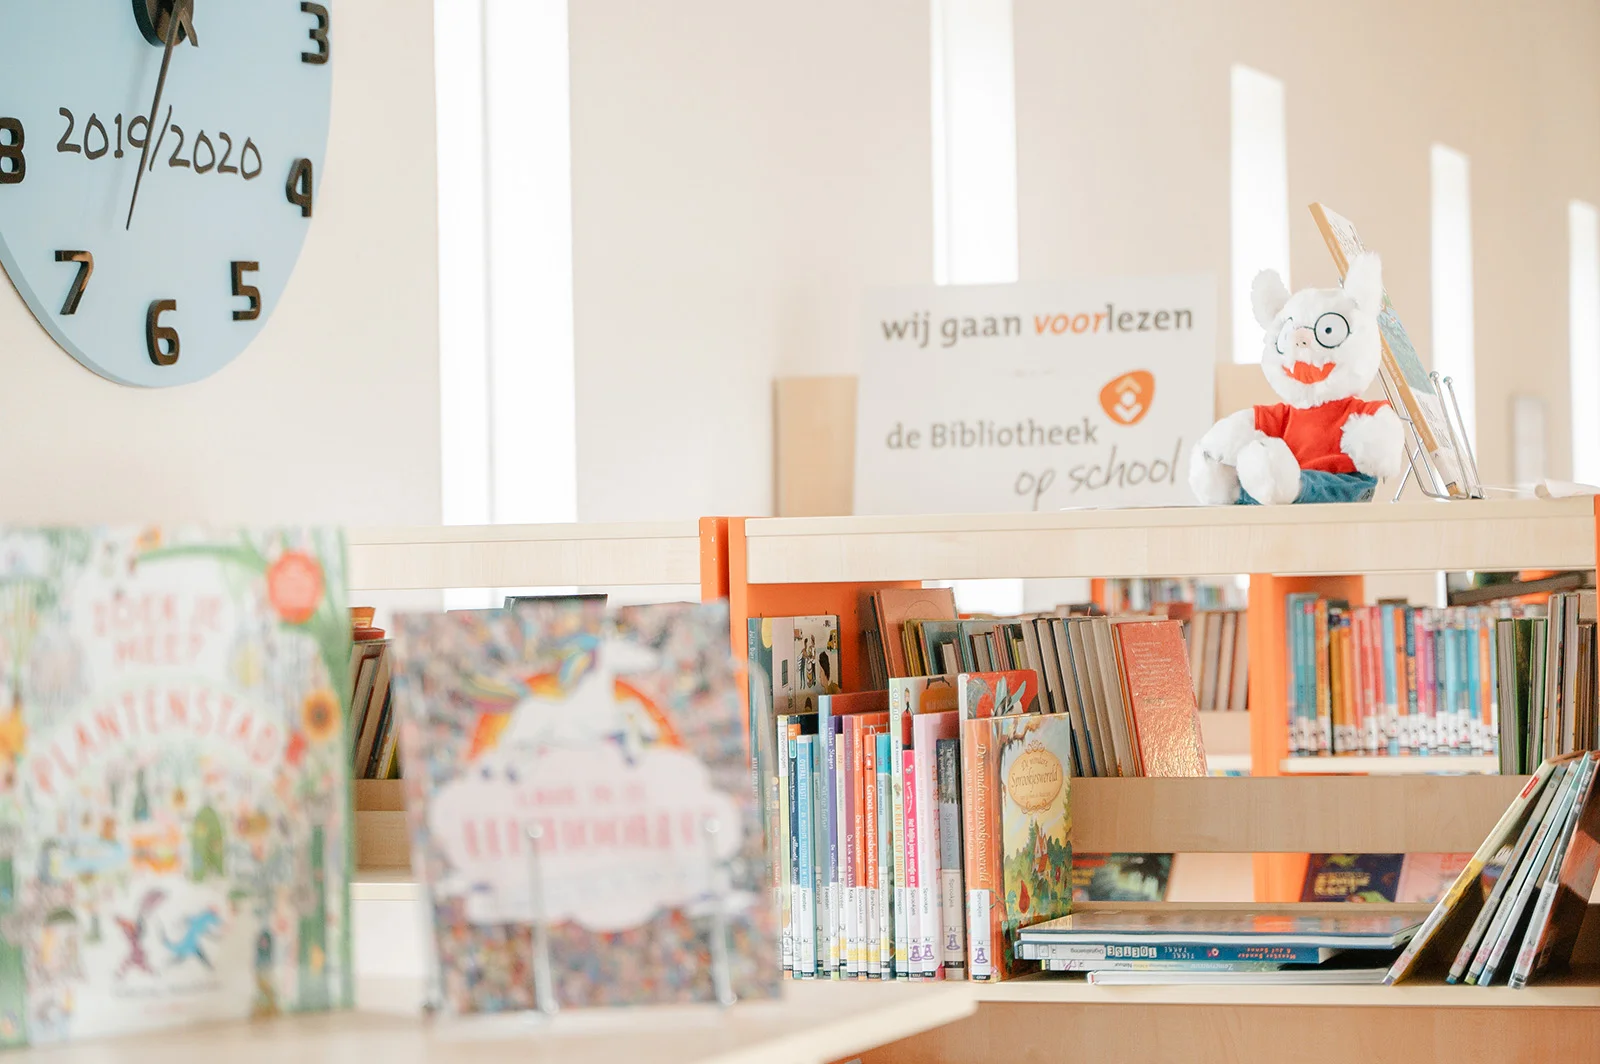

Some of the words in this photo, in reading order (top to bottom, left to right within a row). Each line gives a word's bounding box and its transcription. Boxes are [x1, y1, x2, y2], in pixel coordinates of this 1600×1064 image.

[300, 1, 330, 65] 3
[0, 117, 26, 184] 8
[285, 157, 313, 217] 4
[54, 250, 94, 315] 7
[230, 261, 261, 321] 5
[145, 299, 181, 366] 6
[881, 310, 931, 348] wij
[940, 313, 1021, 348] gaan
[1033, 303, 1193, 336] voorlezen
[886, 421, 921, 450] de
[931, 417, 1099, 449] Bibliotheek
[1014, 468, 1057, 512] op
[1067, 438, 1183, 493] school
[976, 743, 987, 758] De
[866, 784, 874, 811] Groot
[976, 761, 989, 803] wondere
[847, 834, 853, 842] De
[855, 815, 862, 823] De
[865, 811, 876, 865] weetjesboek
[974, 806, 991, 882] sprookjeswereld
[1497, 896, 1513, 921] Dyslexie
[1540, 893, 1551, 913] Pesten
